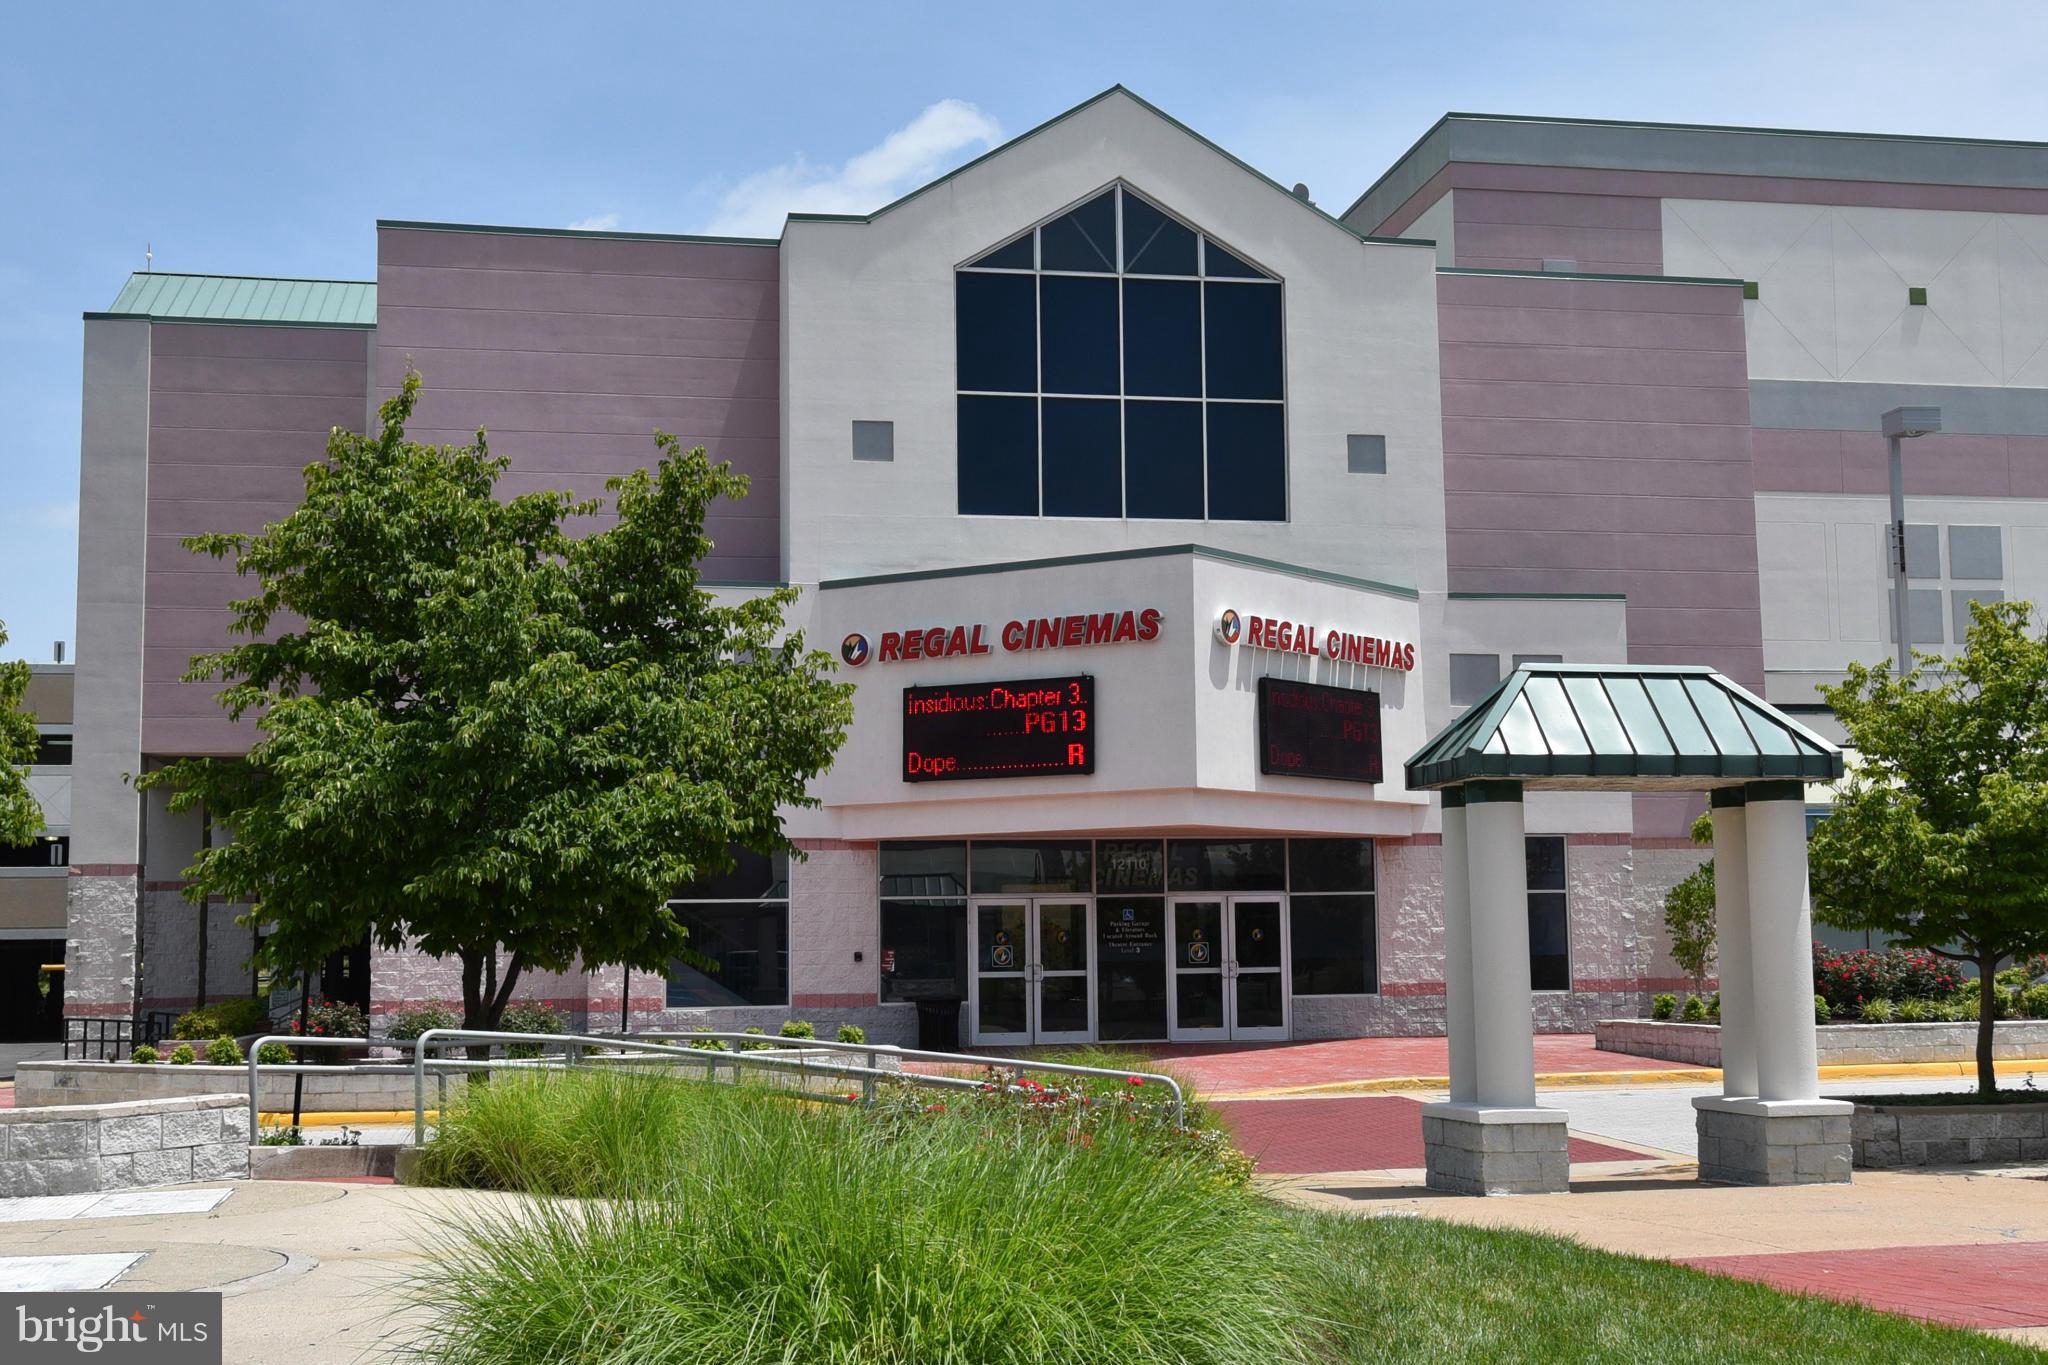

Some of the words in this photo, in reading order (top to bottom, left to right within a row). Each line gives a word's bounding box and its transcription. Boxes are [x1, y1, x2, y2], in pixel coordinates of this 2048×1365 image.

[878, 623, 991, 663] REGAL
[1001, 608, 1162, 652] CINEMAS
[1247, 615, 1320, 656] REGAL
[1326, 629, 1415, 672] CINEMAS
